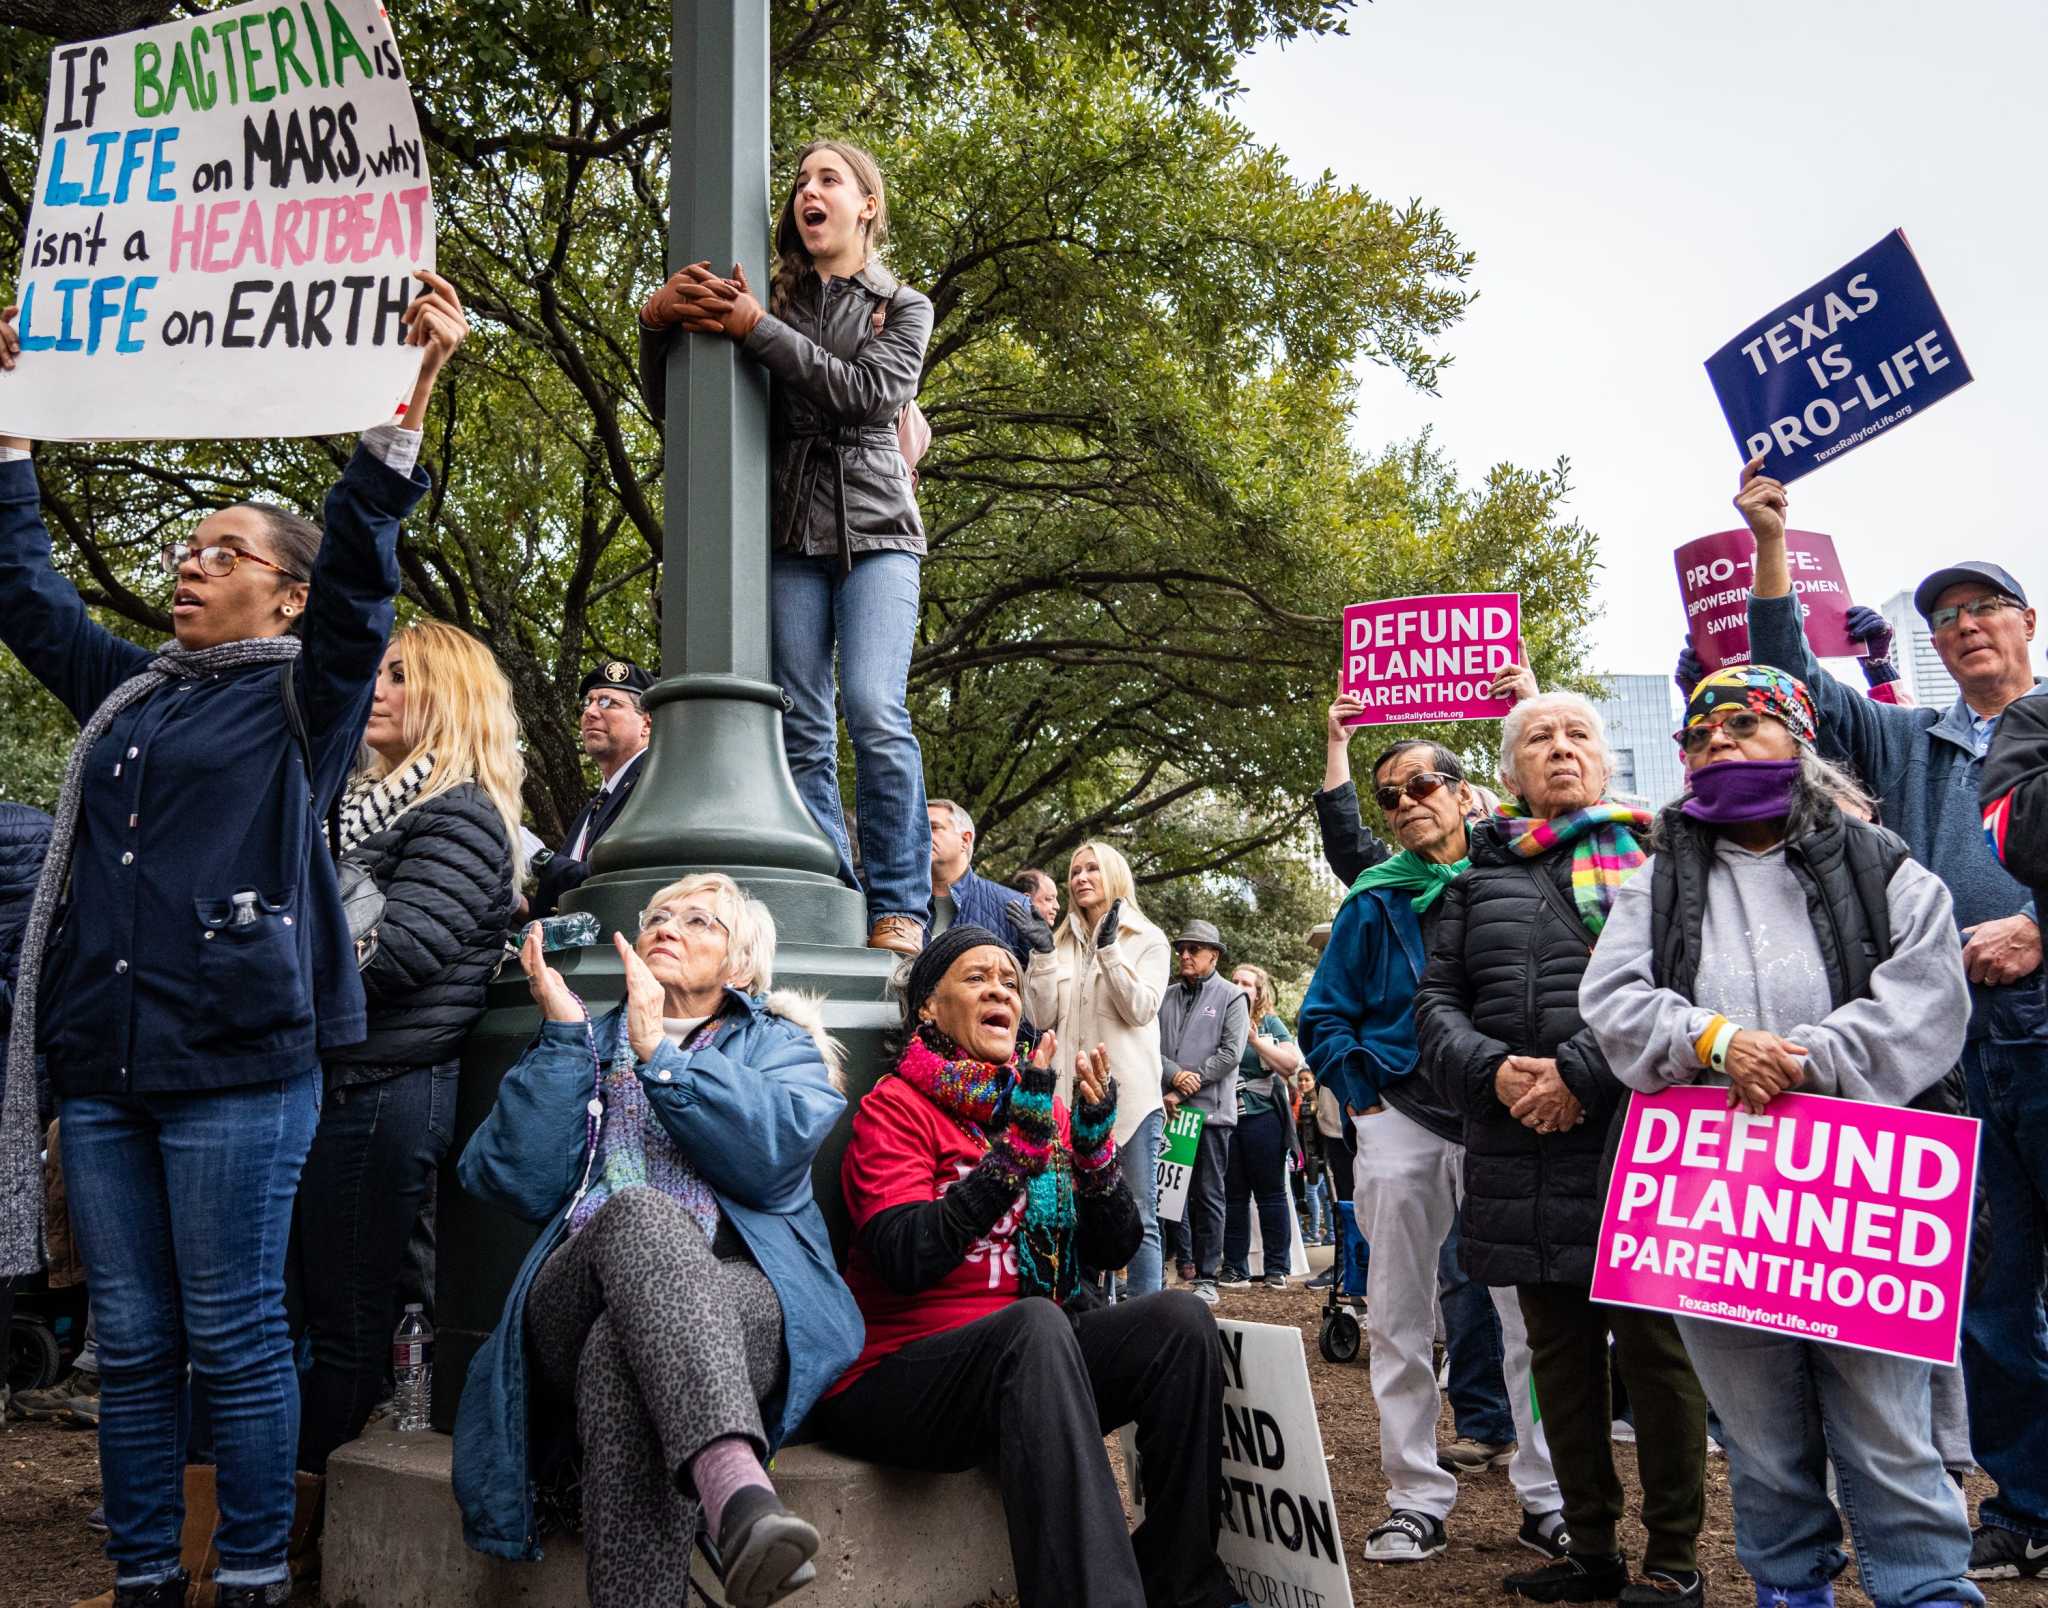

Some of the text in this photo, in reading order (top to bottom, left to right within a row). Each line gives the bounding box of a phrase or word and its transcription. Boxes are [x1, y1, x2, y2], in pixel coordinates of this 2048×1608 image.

[54, 0, 401, 133] If BACTERIA is
[43, 101, 420, 206] LIFE on MARS, why
[31, 186, 429, 273] isn't a HEARTBEAT
[18, 276, 158, 355] LIFE
[162, 309, 213, 348] on
[1741, 272, 1879, 376] TEXAS
[1746, 329, 1951, 472] PRO-LIFE
[1807, 343, 1852, 389] IS
[1813, 404, 1912, 462] TexasRallyforLife.org
[1686, 552, 1822, 591] PRO-FE:
[1349, 645, 1512, 683] PLANNED
[1350, 608, 1512, 650] DEFUND
[1349, 680, 1512, 707] PARENTHOO
[1385, 710, 1464, 721] TexasRallyforLife.org
[1631, 1107, 1960, 1201] DEFUND
[1617, 1172, 1952, 1267] PLANNED
[1609, 1232, 1945, 1321] PARENTHOOD
[1678, 1295, 1838, 1338] TexasRallyforLife.org
[1219, 1475, 1339, 1565] RTION
